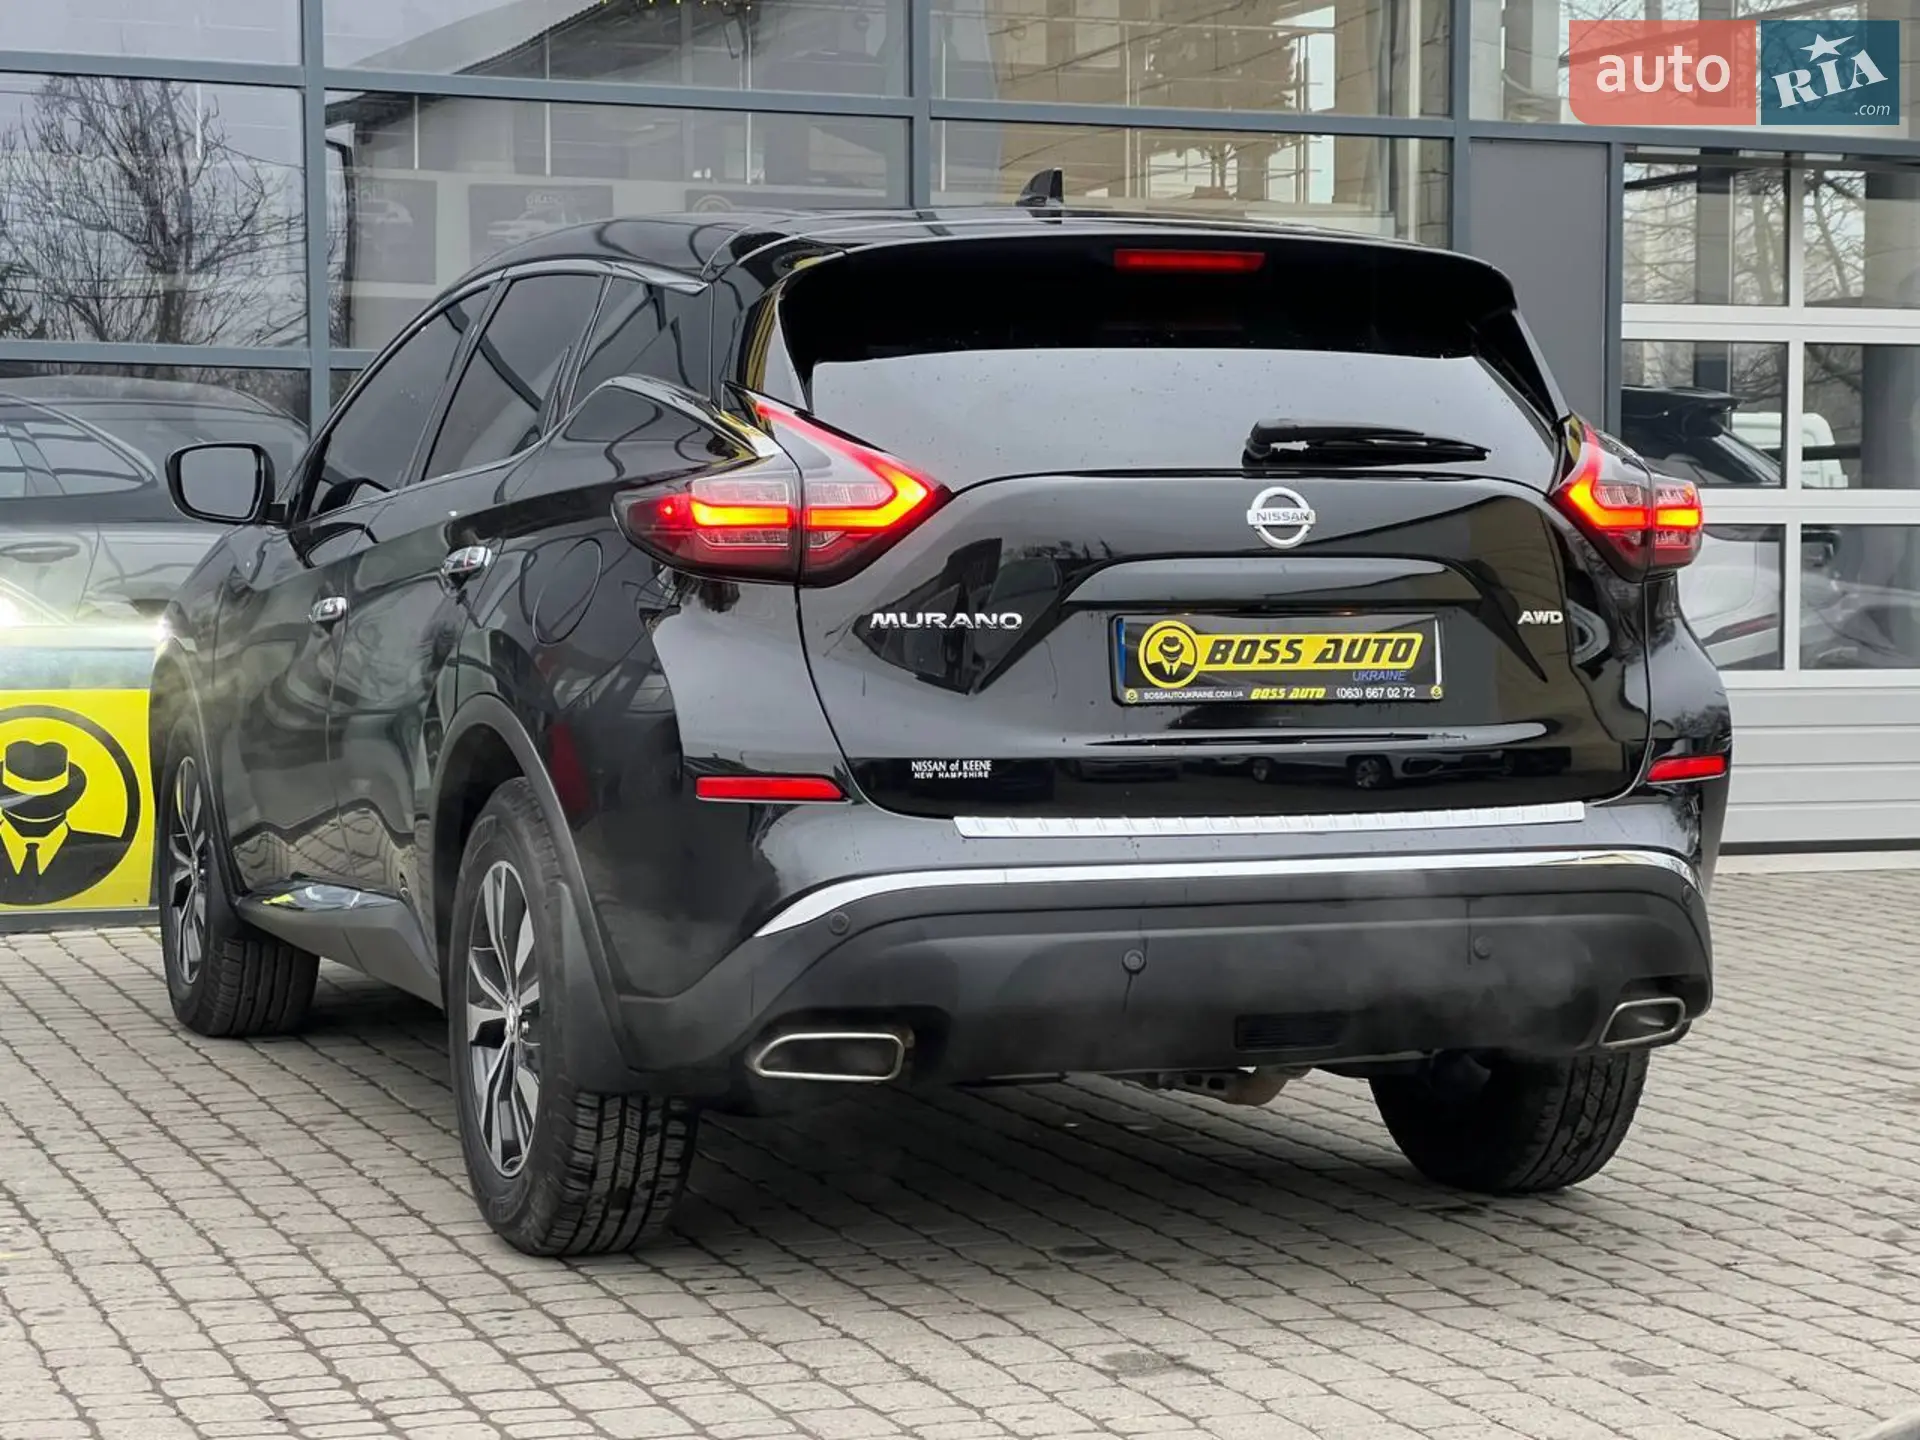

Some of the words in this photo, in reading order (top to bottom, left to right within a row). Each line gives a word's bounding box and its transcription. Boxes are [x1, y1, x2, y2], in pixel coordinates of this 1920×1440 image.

[1255, 510, 1312, 523] NISSAN
[869, 612, 1023, 630] MURANO
[1517, 610, 1564, 625] AWD
[1205, 638, 1305, 665] BOSS
[1312, 637, 1417, 664] AUTO
[1352, 670, 1408, 682] UKRAINE
[1143, 689, 1244, 700] BOSSAUTOUKRAINE.COM.UA
[1250, 688, 1287, 699] BOSS
[1288, 687, 1327, 699] AUTO
[1336, 687, 1364, 699] (063)
[1365, 687, 1384, 698] 667
[1386, 687, 1401, 698] 02
[1402, 687, 1416, 698] 72
[911, 761, 947, 772] NISSAN
[949, 760, 959, 771] of
[963, 760, 992, 771] KEENE
[938, 771, 989, 779] HAMPSHIRE
